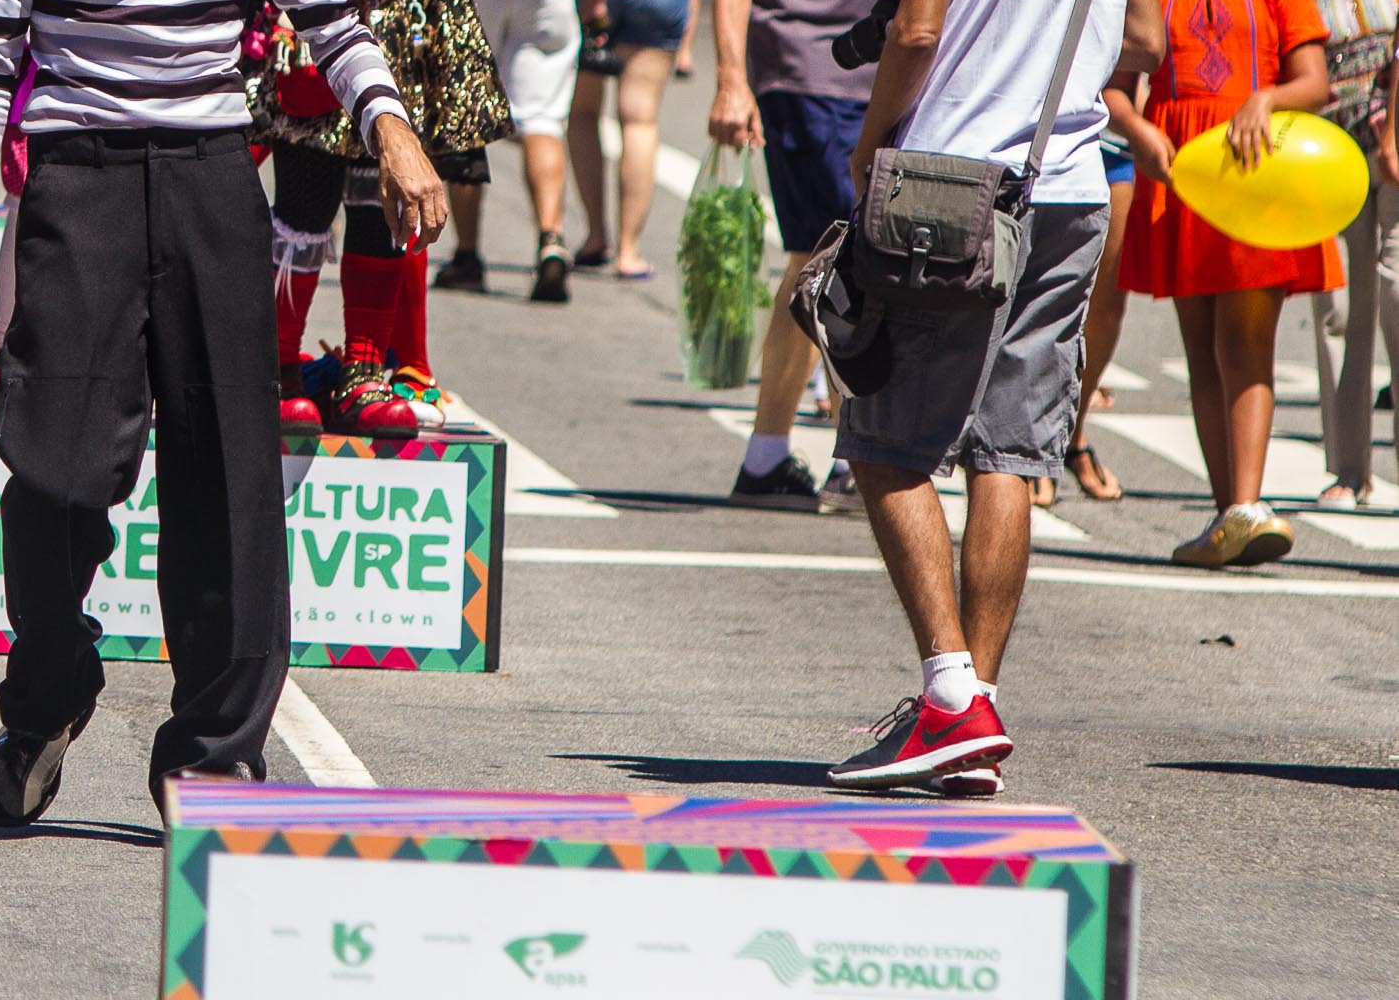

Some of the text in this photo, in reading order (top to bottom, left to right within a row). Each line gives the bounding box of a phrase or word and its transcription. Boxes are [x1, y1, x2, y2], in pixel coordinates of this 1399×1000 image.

[285, 482, 453, 524] ULTURA
[286, 528, 451, 592] IVRE
[364, 543, 392, 561] SP
[86, 598, 151, 615] lown
[293, 607, 434, 627] ção clown
[814, 942, 1001, 962] GOVERNO DO ESTADO
[812, 955, 999, 992] SÃO PAULO
